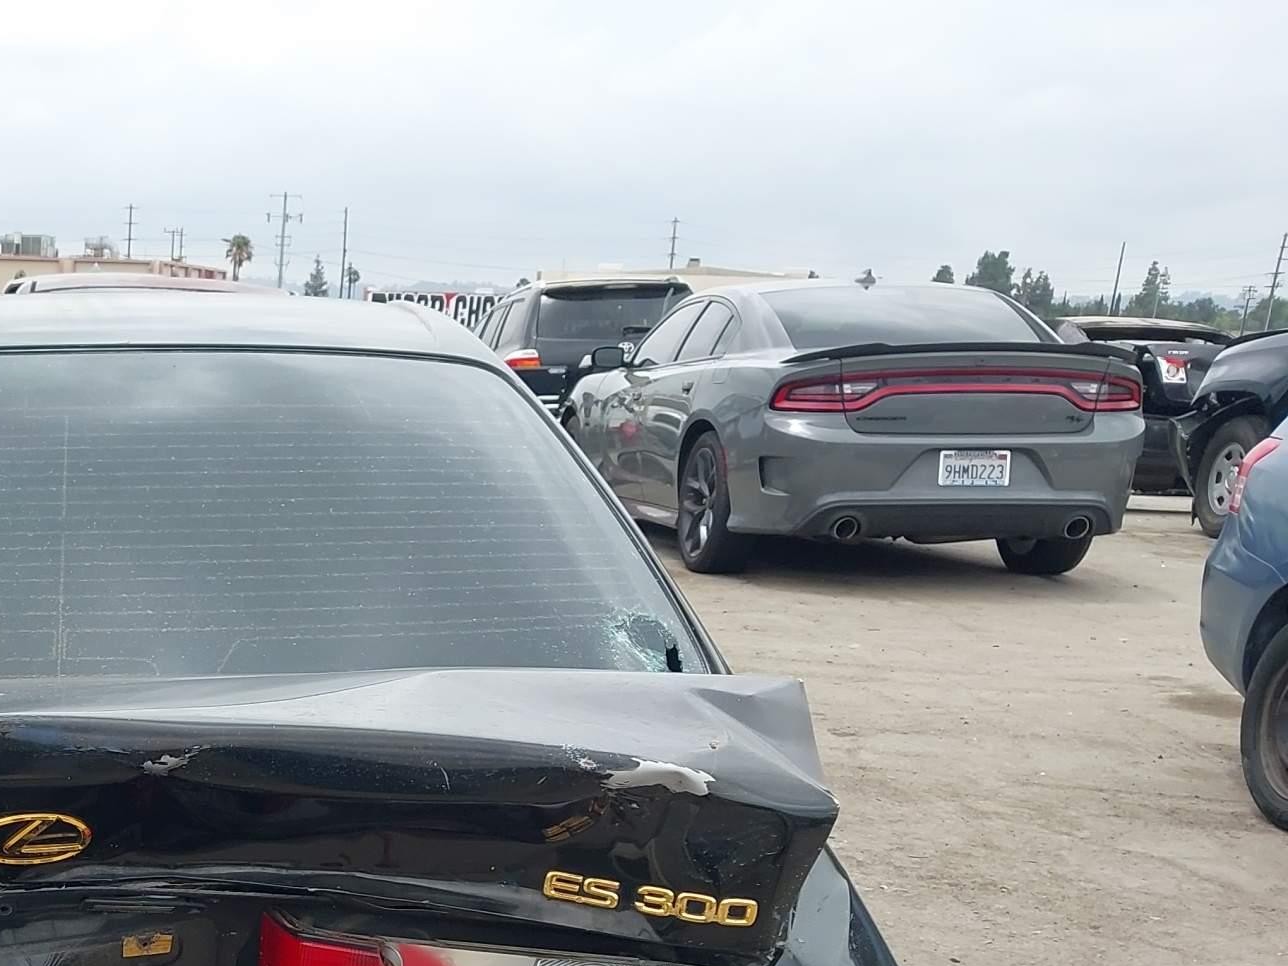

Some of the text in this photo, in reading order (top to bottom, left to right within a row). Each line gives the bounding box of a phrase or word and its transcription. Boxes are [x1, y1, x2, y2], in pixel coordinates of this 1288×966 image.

[945, 464, 1005, 480] 9HMD223
[543, 870, 759, 927] ES 300
